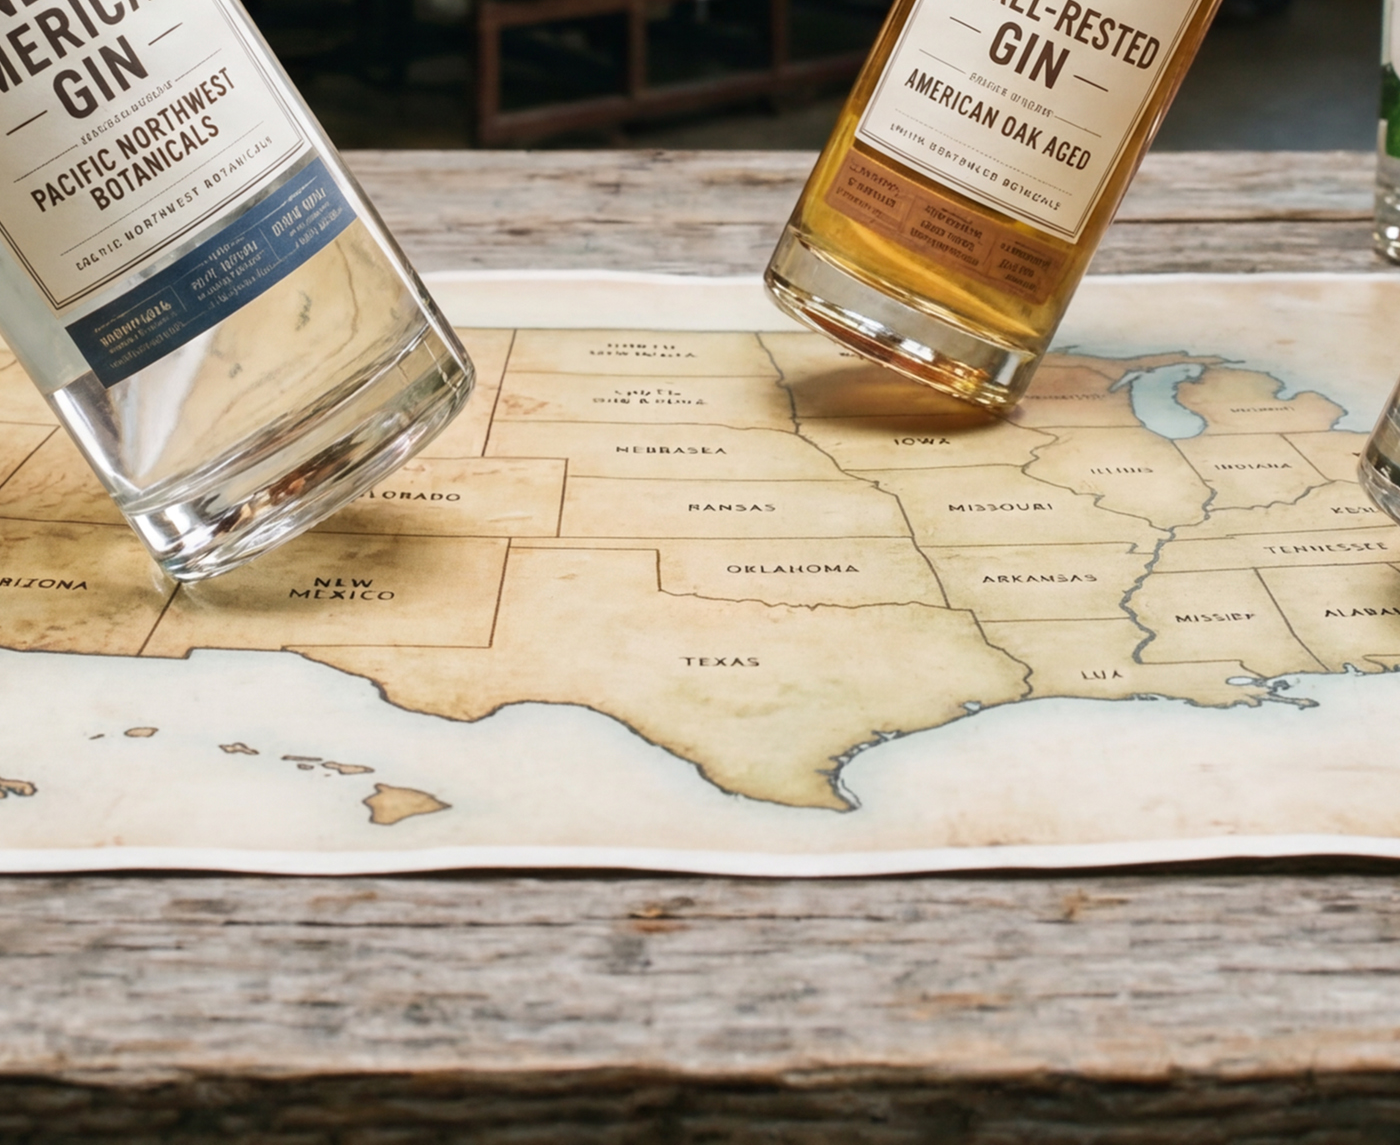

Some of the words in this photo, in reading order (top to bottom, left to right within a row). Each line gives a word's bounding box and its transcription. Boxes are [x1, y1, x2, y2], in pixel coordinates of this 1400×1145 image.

[52, 35, 149, 119] GIN
[988, 21, 1070, 90] GIN
[30, 148, 117, 213] PACIFIC
[115, 67, 235, 160] NORTHWEST
[904, 68, 1000, 129] AMERICAN
[1001, 116, 1043, 150] OAK
[1042, 135, 1091, 170] AGED
[90, 115, 220, 211] BOTANICALS
[288, 588, 395, 600] MEXICO
[727, 565, 859, 573] OKLAHOMA
[983, 574, 1097, 584] ARKANSAS
[679, 657, 760, 667] TEXAS
